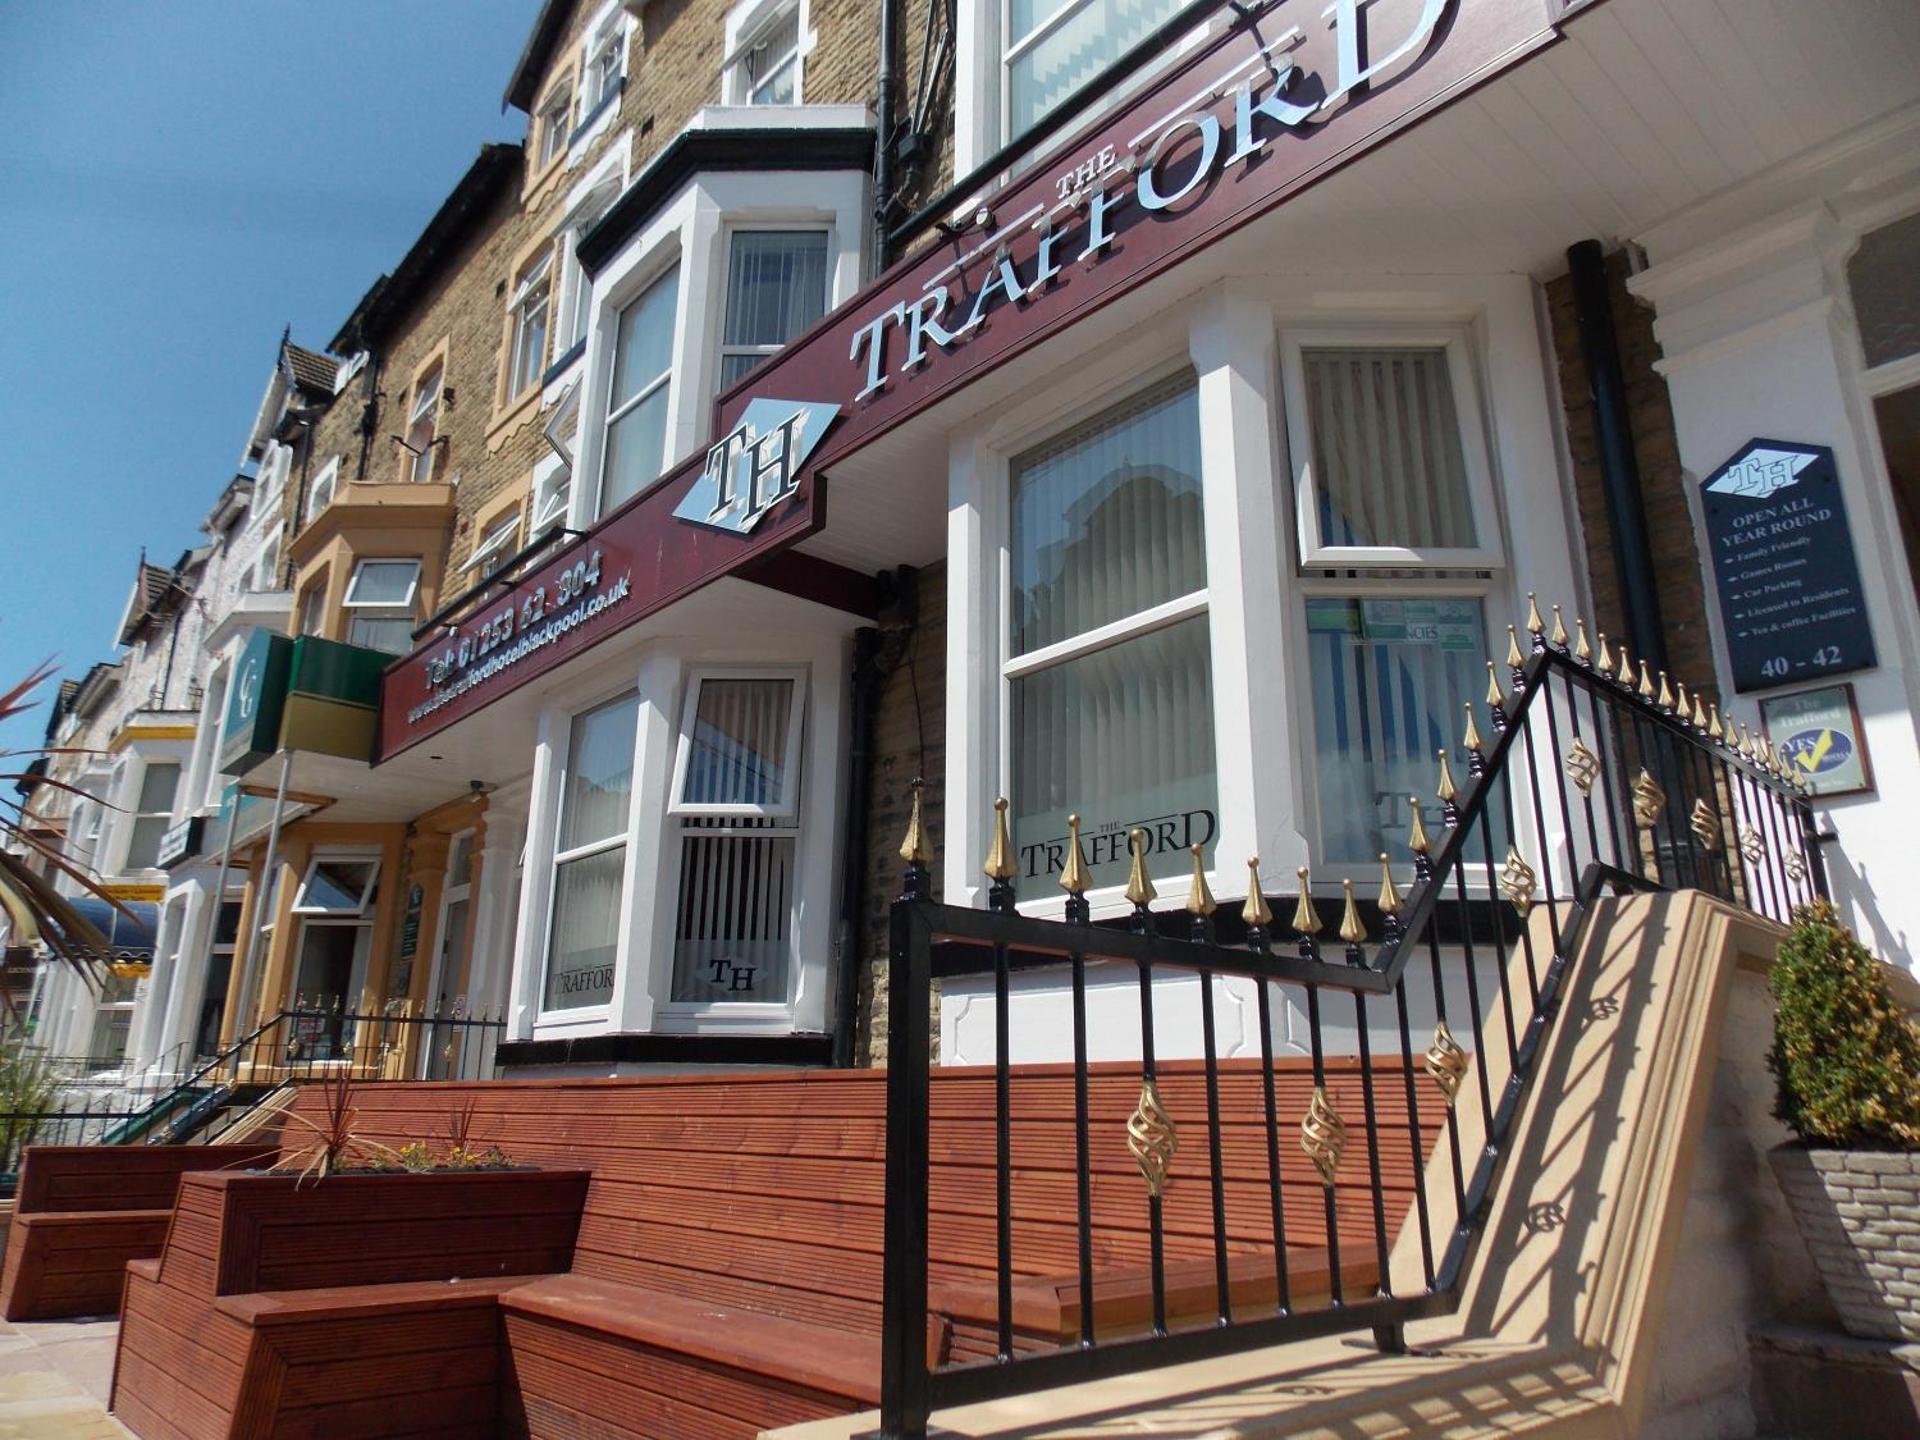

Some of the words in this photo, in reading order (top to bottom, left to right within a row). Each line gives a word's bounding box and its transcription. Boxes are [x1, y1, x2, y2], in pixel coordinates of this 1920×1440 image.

[1056, 143, 1120, 200] THE
[849, 0, 1450, 402] TRAFFORD
[705, 407, 809, 528] TH
[1732, 505, 1777, 528] OPEN
[1781, 498, 1815, 515] ALL
[1721, 527, 1767, 547] YEAR
[1770, 508, 1832, 534] ROUND
[1737, 546, 1768, 562] Family
[1771, 536, 1811, 553] Friendly
[1740, 565, 1773, 581] Games
[1743, 588, 1762, 599] Car
[1764, 578, 1802, 594] Parking
[1747, 601, 1788, 618] Licensed
[1770, 622, 1780, 632] &
[1761, 656, 1789, 678] 40
[1812, 645, 1843, 667] 42
[1784, 736, 1817, 753] YES
[1099, 820, 1121, 832] THE
[555, 968, 614, 994] TRAFFOR
[708, 959, 757, 992] TH
